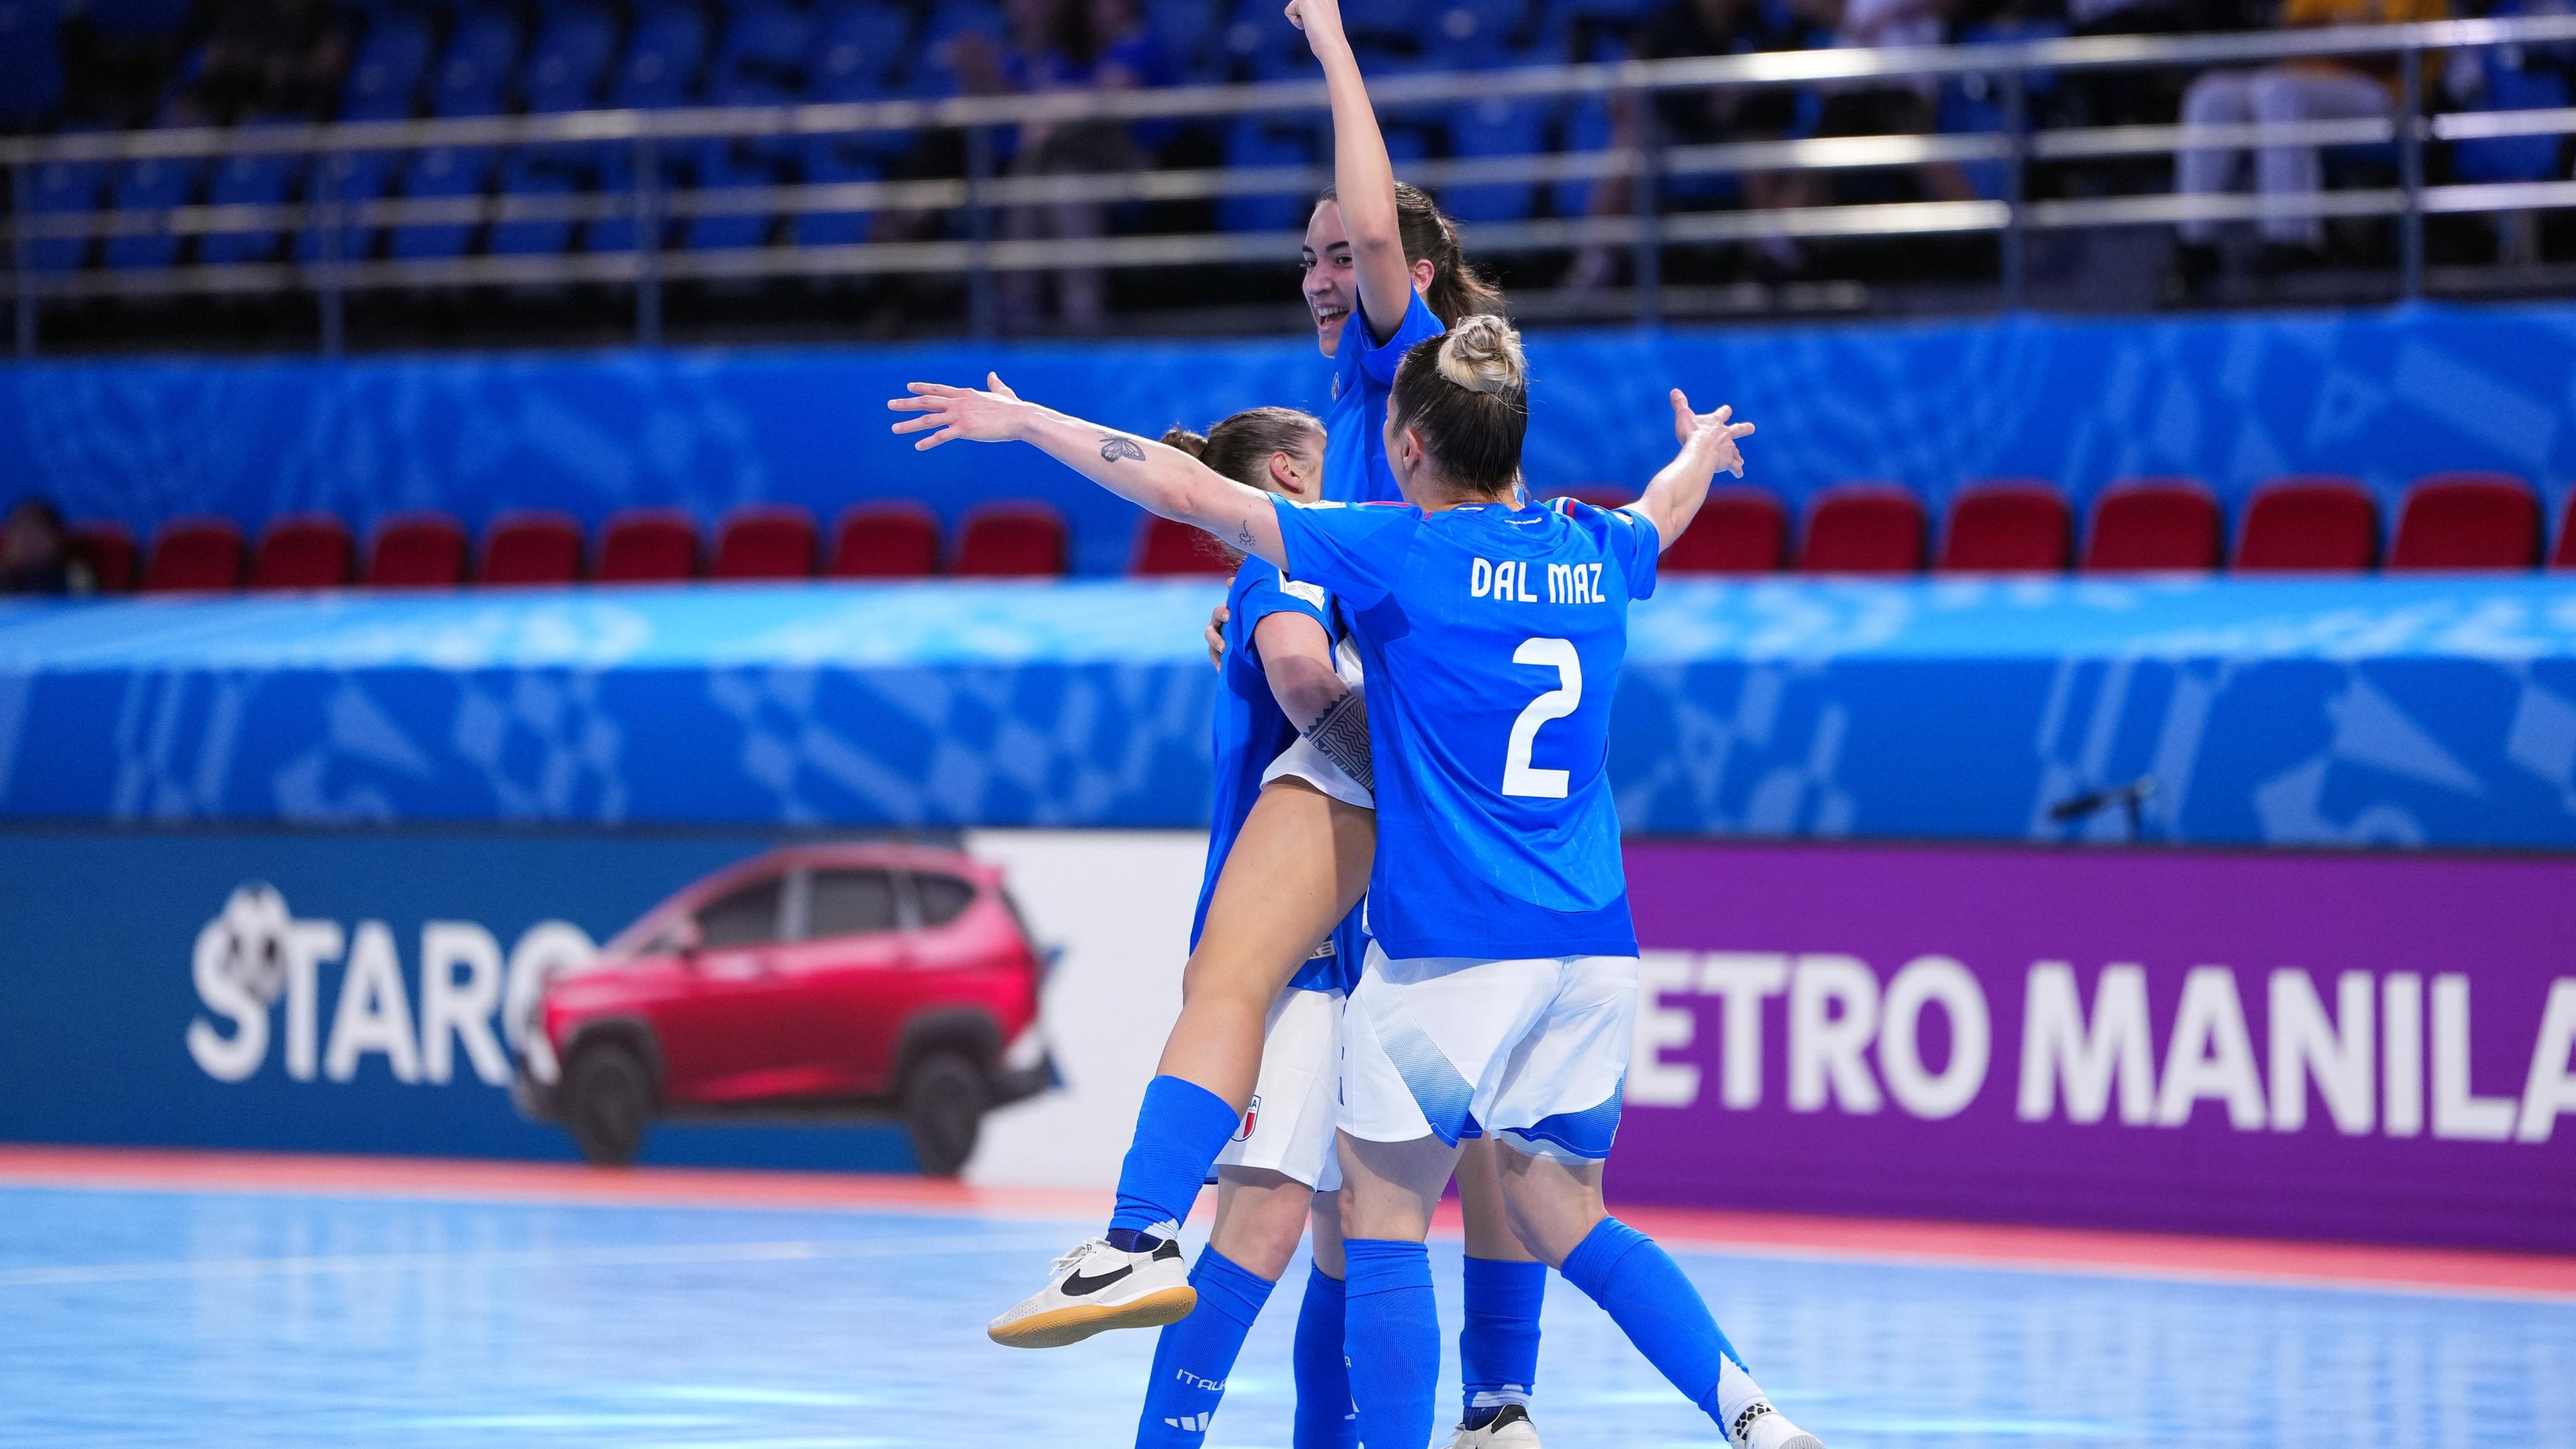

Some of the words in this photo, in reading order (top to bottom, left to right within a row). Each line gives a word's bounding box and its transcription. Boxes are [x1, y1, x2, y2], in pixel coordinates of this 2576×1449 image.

[1470, 557, 1538, 604] DAL
[1549, 564, 1606, 604] MAZ
[1502, 638, 1582, 798] 2
[1626, 951, 1990, 1119] ETRO
[2019, 961, 2576, 1142] MANILA
